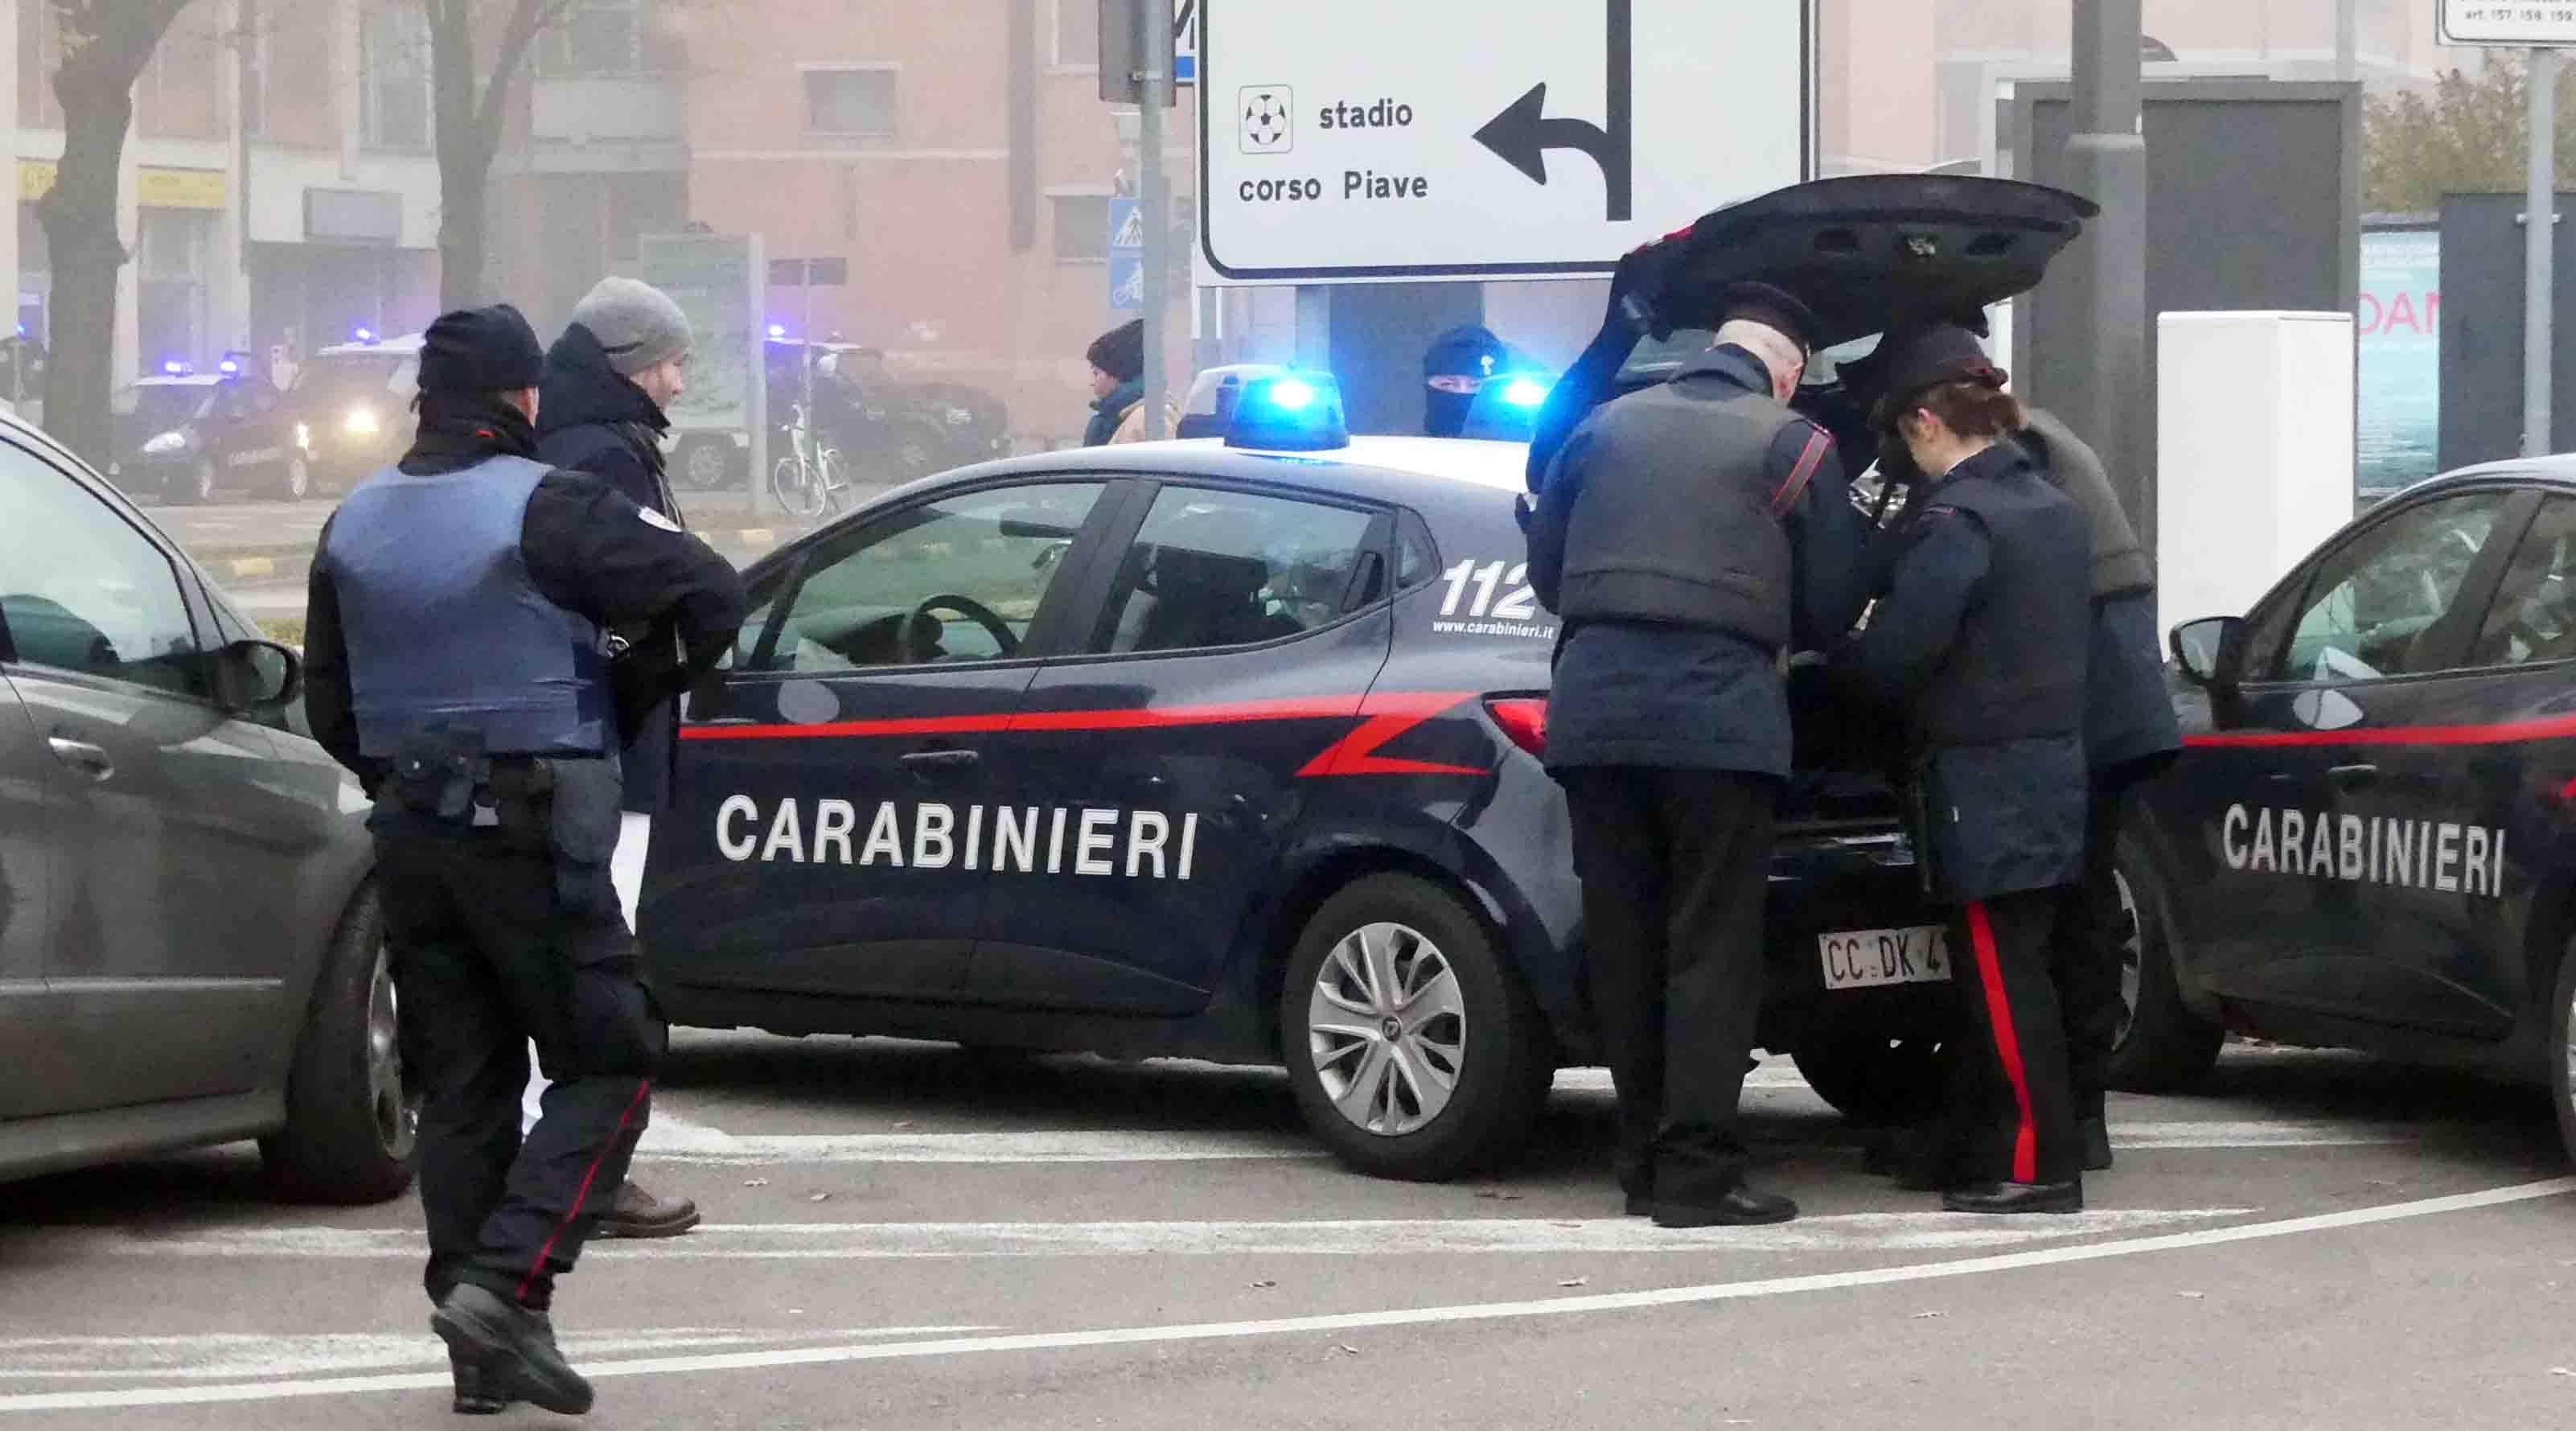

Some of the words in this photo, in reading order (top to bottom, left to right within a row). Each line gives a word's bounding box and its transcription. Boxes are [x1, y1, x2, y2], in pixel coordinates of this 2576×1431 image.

[1319, 97, 1413, 129] stadio
[1239, 177, 1321, 201] corso
[1344, 169, 1428, 199] Piave
[1440, 559, 1535, 620] 112
[1432, 620, 1555, 639] www.carabinieri.it
[716, 794, 1198, 880] CARABINIERI
[2222, 803, 2505, 898] CARABINIERI
[1827, 938, 1863, 981] CC
[1878, 933, 1916, 977] DK
